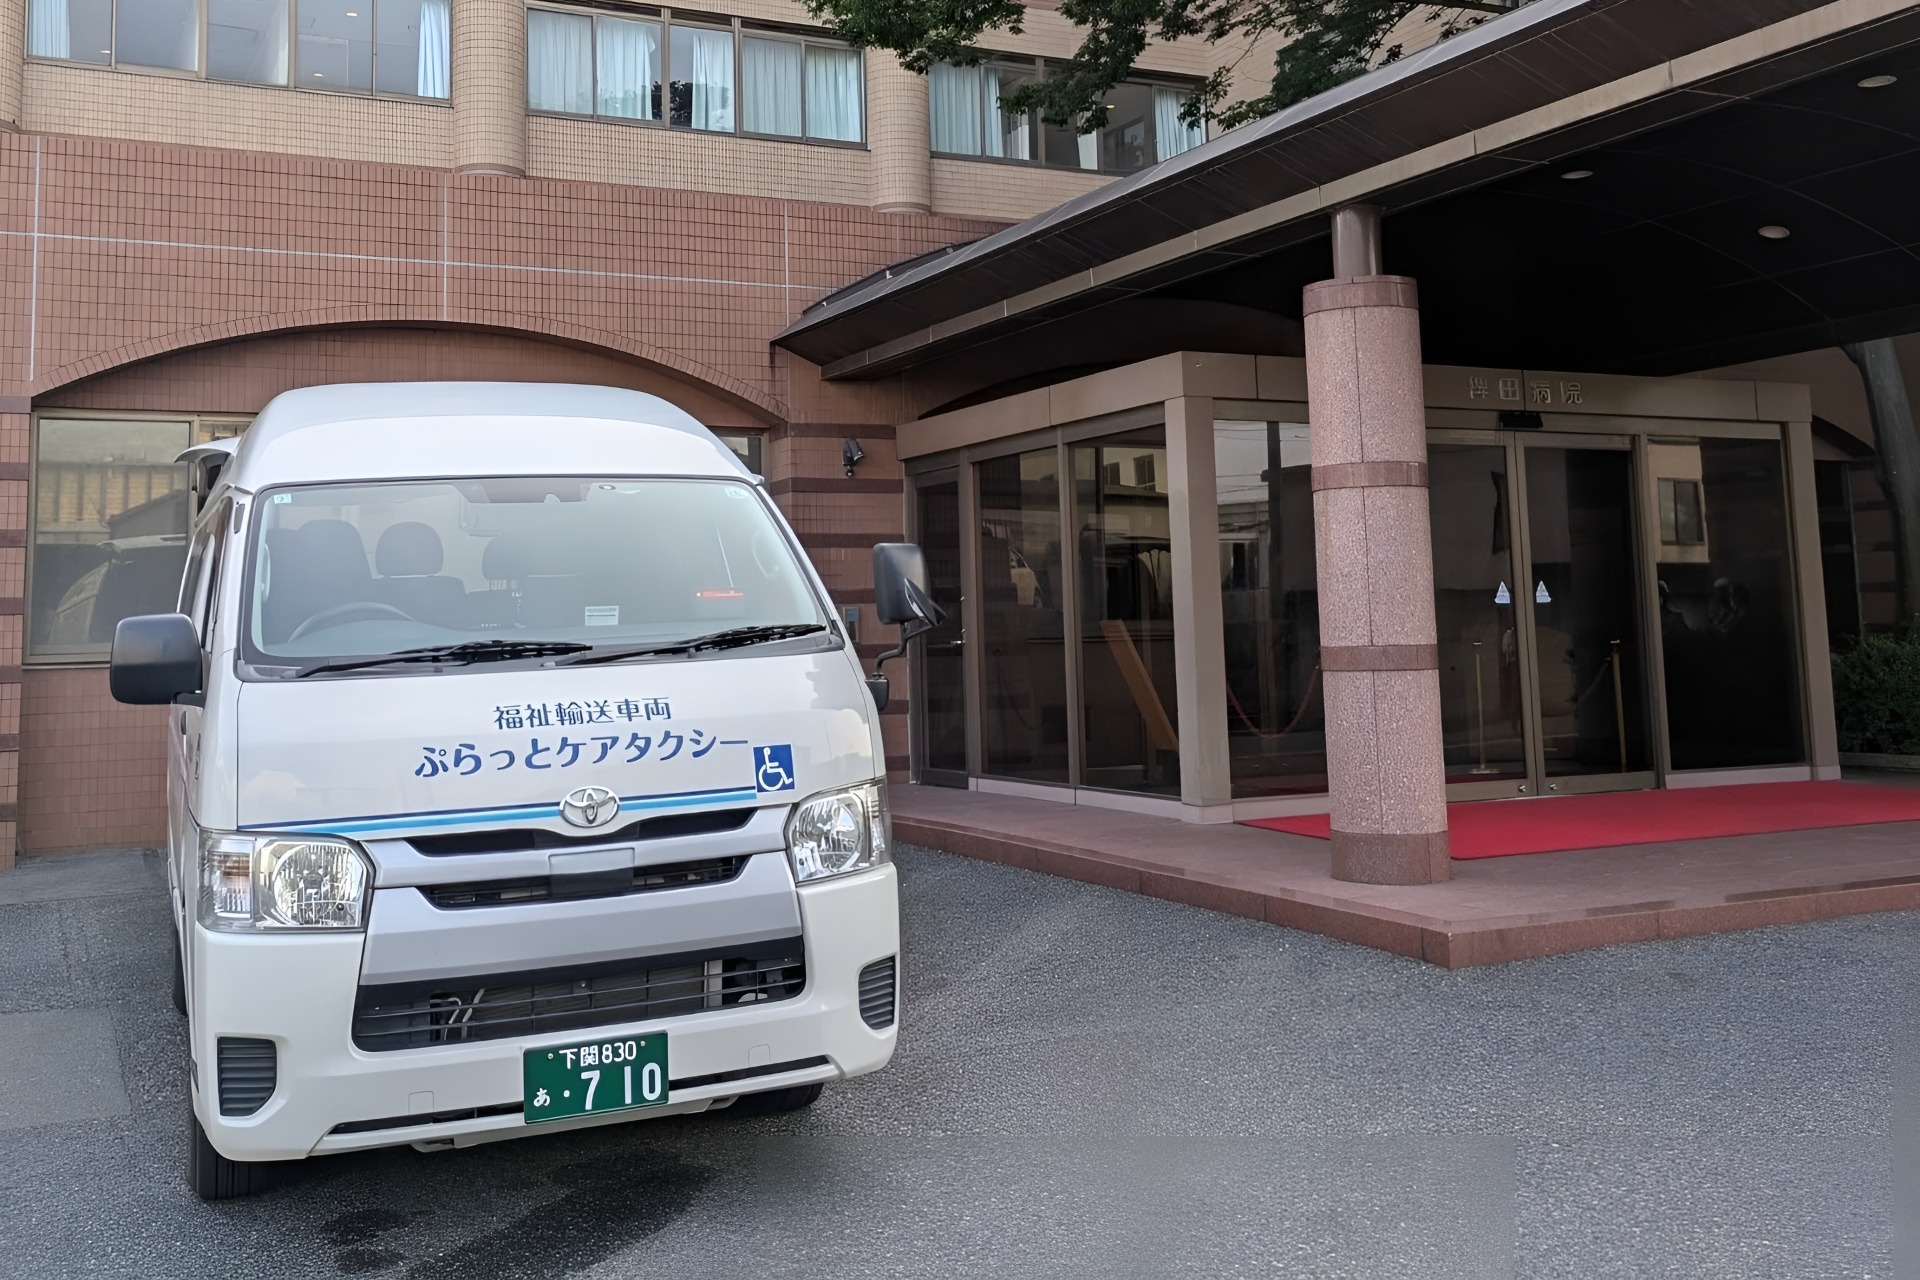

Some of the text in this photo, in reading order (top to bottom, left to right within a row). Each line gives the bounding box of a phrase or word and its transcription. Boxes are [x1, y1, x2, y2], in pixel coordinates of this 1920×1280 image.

[493, 696, 672, 730] 福祉輸送車両
[414, 729, 749, 778] ぷらっとケアタクシー
